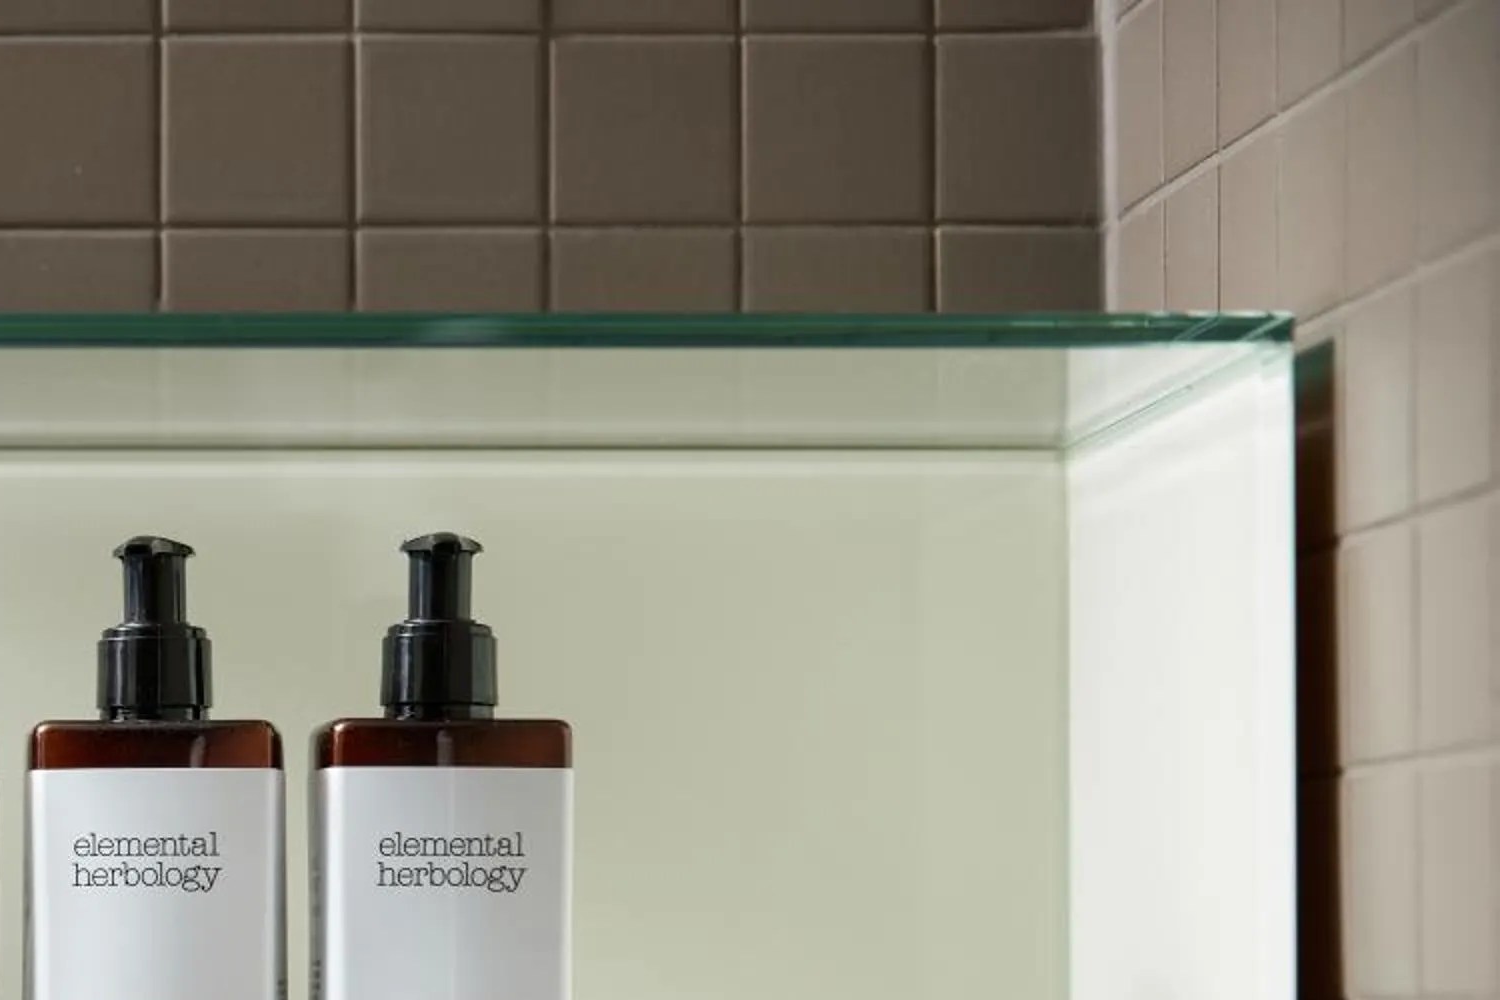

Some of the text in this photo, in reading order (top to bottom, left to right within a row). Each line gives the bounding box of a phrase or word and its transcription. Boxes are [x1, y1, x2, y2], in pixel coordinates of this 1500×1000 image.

[73, 831, 221, 857] elemental
[378, 831, 526, 857] elemental
[71, 861, 223, 893] herbology
[376, 861, 529, 893] herbology
